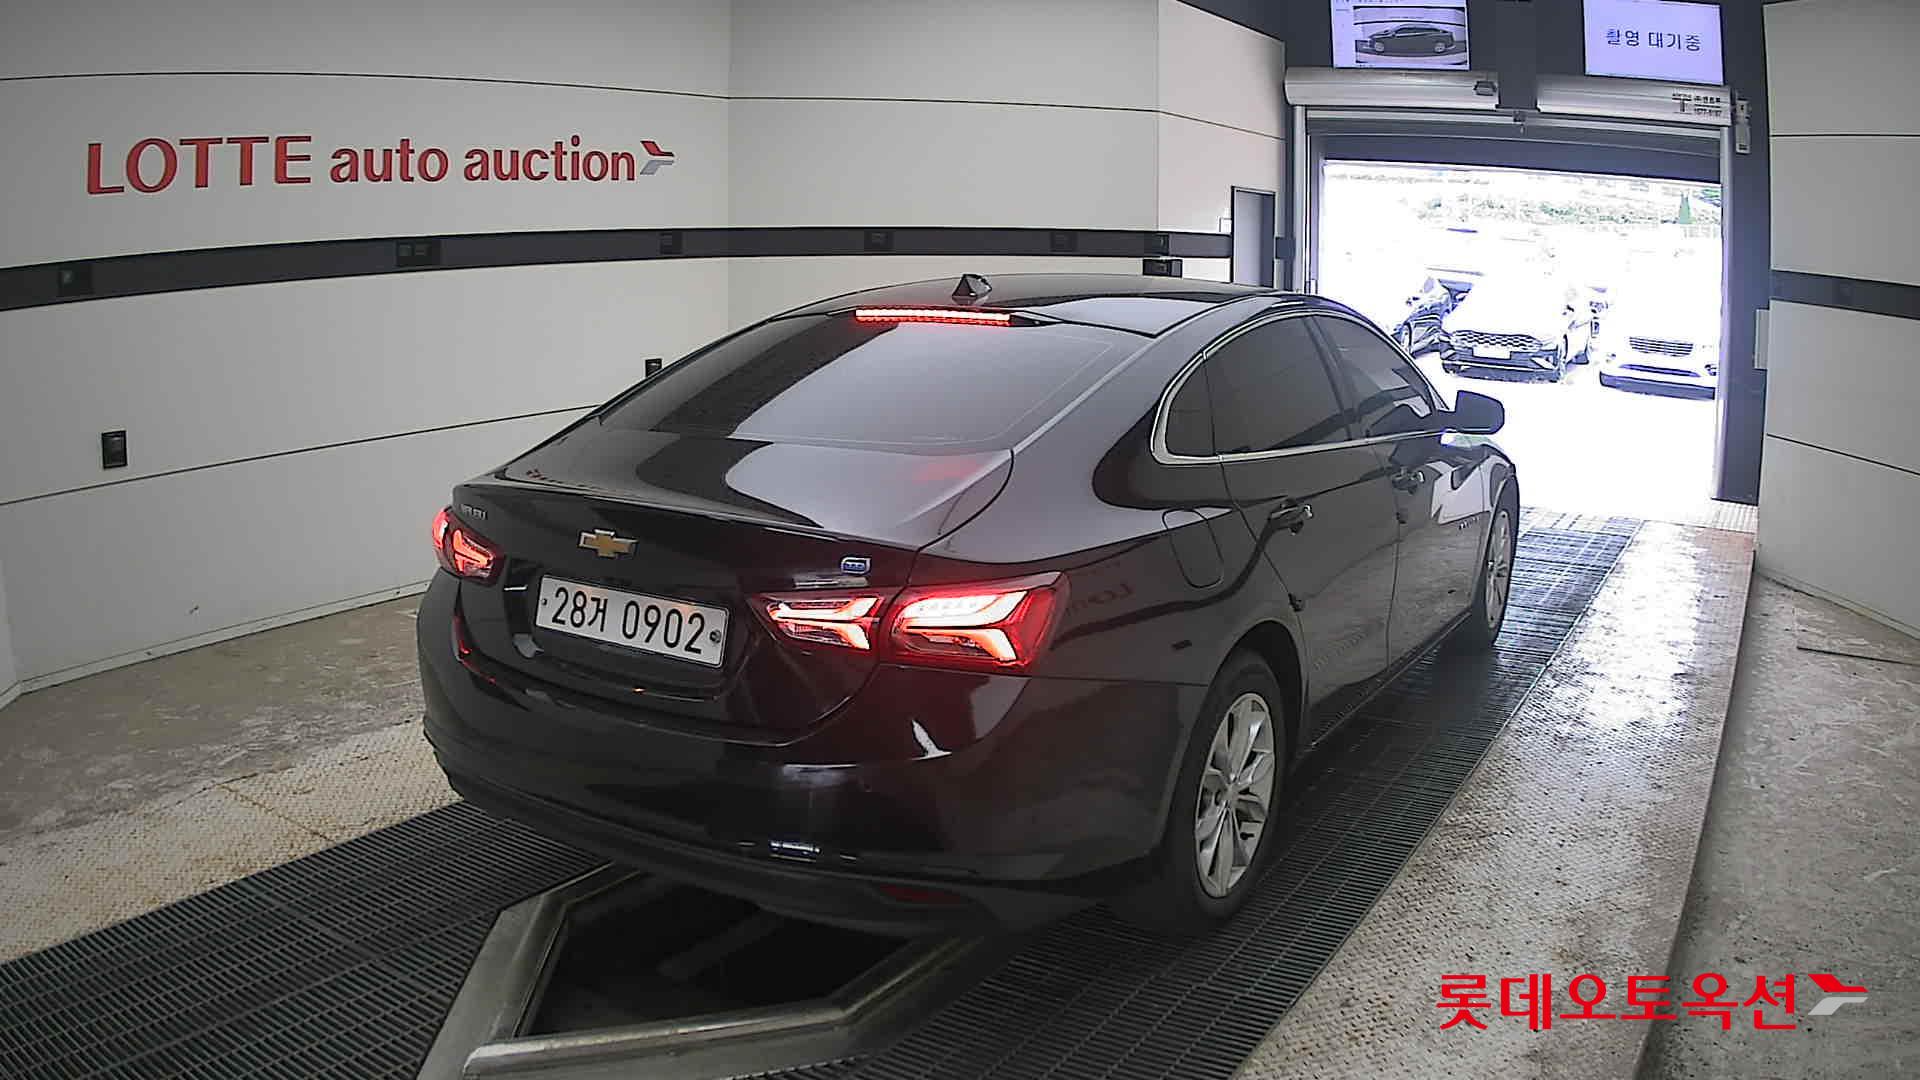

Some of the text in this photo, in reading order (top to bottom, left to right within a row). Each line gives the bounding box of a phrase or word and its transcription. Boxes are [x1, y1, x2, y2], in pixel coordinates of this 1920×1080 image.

[1648, 31, 1701, 52] 대기중
[87, 134, 636, 195] LOTTE auto auction
[551, 587, 705, 655] 28거 0902
